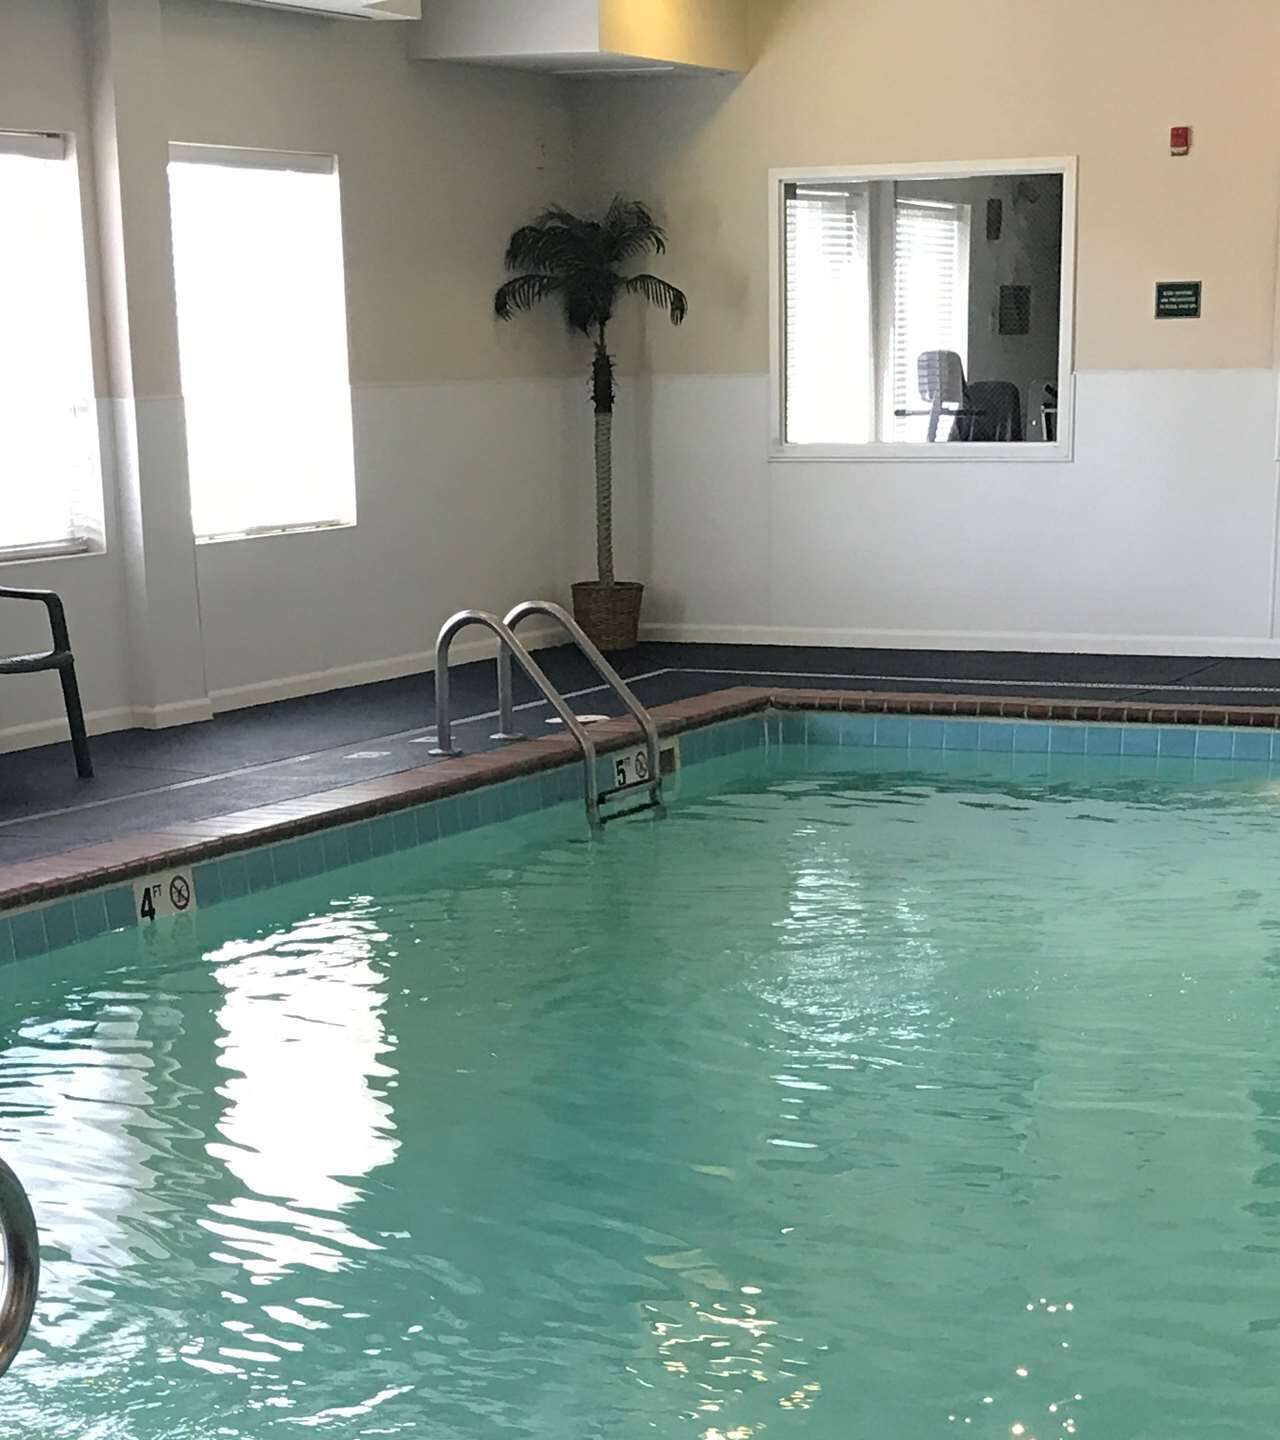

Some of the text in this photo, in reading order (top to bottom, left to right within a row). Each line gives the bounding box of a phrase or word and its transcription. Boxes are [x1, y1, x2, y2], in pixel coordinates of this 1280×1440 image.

[616, 760, 626, 785] 5
[141, 884, 162, 921] 4 FT
